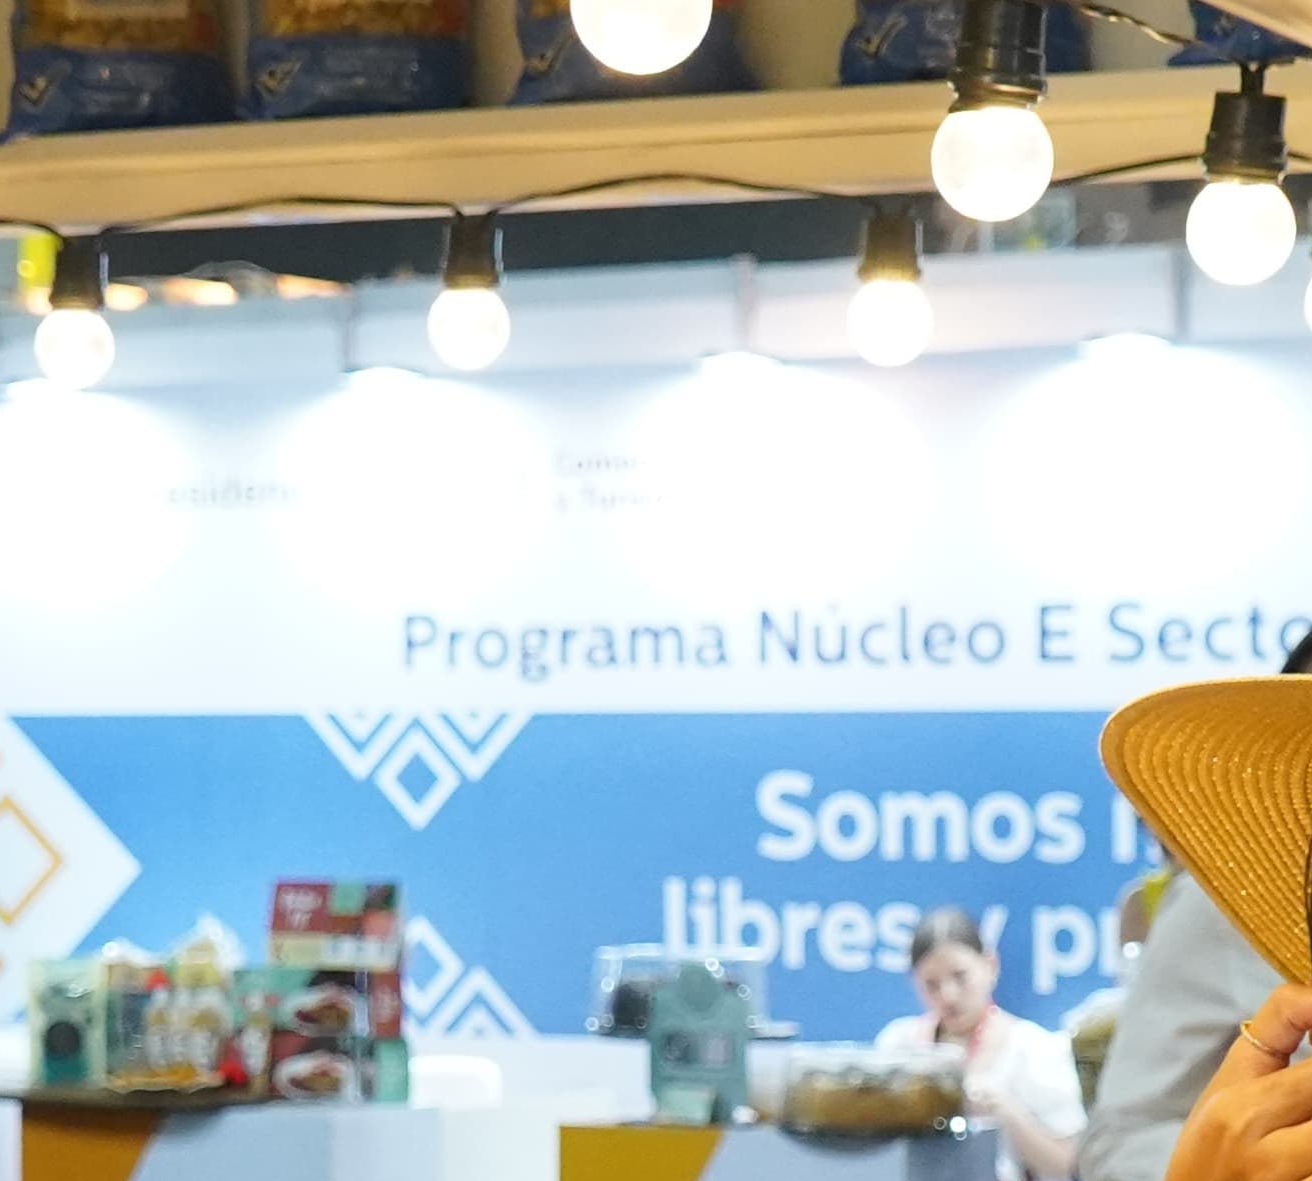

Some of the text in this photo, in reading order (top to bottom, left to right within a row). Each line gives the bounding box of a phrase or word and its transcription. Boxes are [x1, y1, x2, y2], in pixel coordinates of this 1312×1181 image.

[403, 613, 731, 684] Programa
[757, 603, 1007, 665] Núcleo
[1040, 604, 1075, 662] E
[756, 768, 1088, 865] Somos
[662, 874, 922, 972] libres
